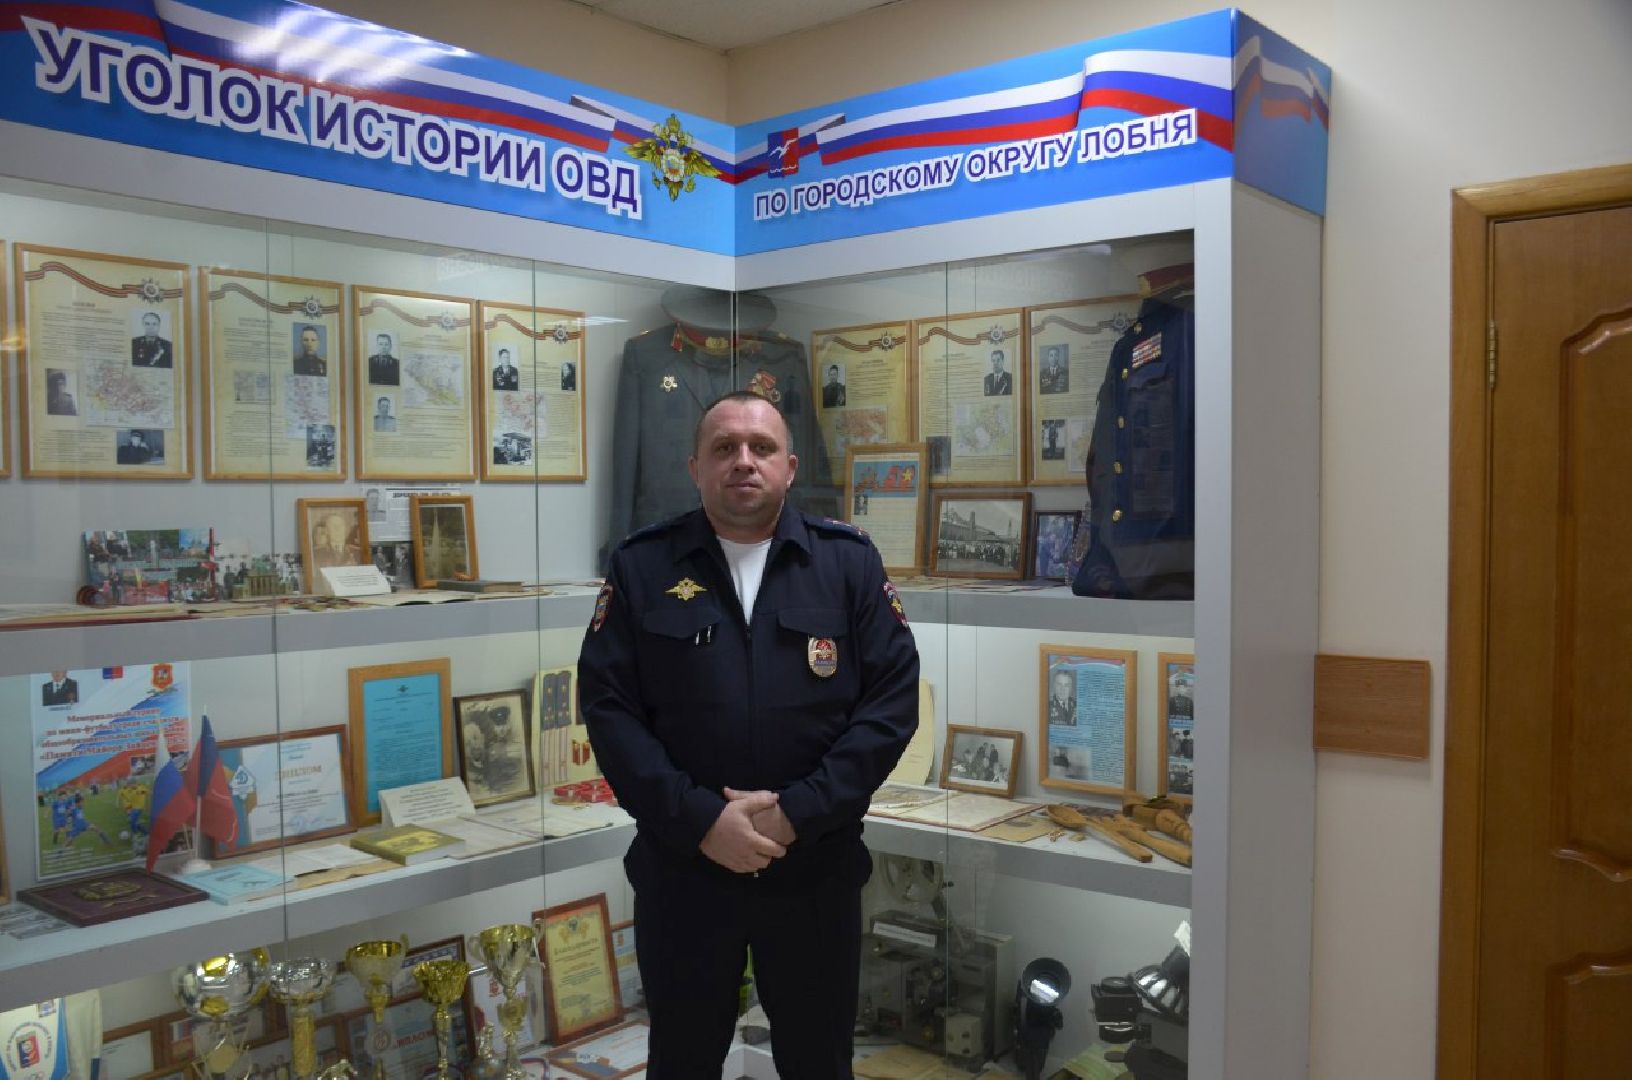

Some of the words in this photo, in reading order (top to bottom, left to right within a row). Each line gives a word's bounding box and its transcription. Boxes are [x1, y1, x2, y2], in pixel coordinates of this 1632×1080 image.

[35, 26, 299, 134] УГОЛОК
[316, 101, 543, 186] ИСТОРИИ
[555, 156, 640, 214] ОВД
[755, 189, 787, 218] ПО
[793, 158, 959, 211] ГОРОДСКОМУ
[967, 137, 1073, 177] ОКРУГУ
[1082, 114, 1194, 158] ЛОБНЯ
